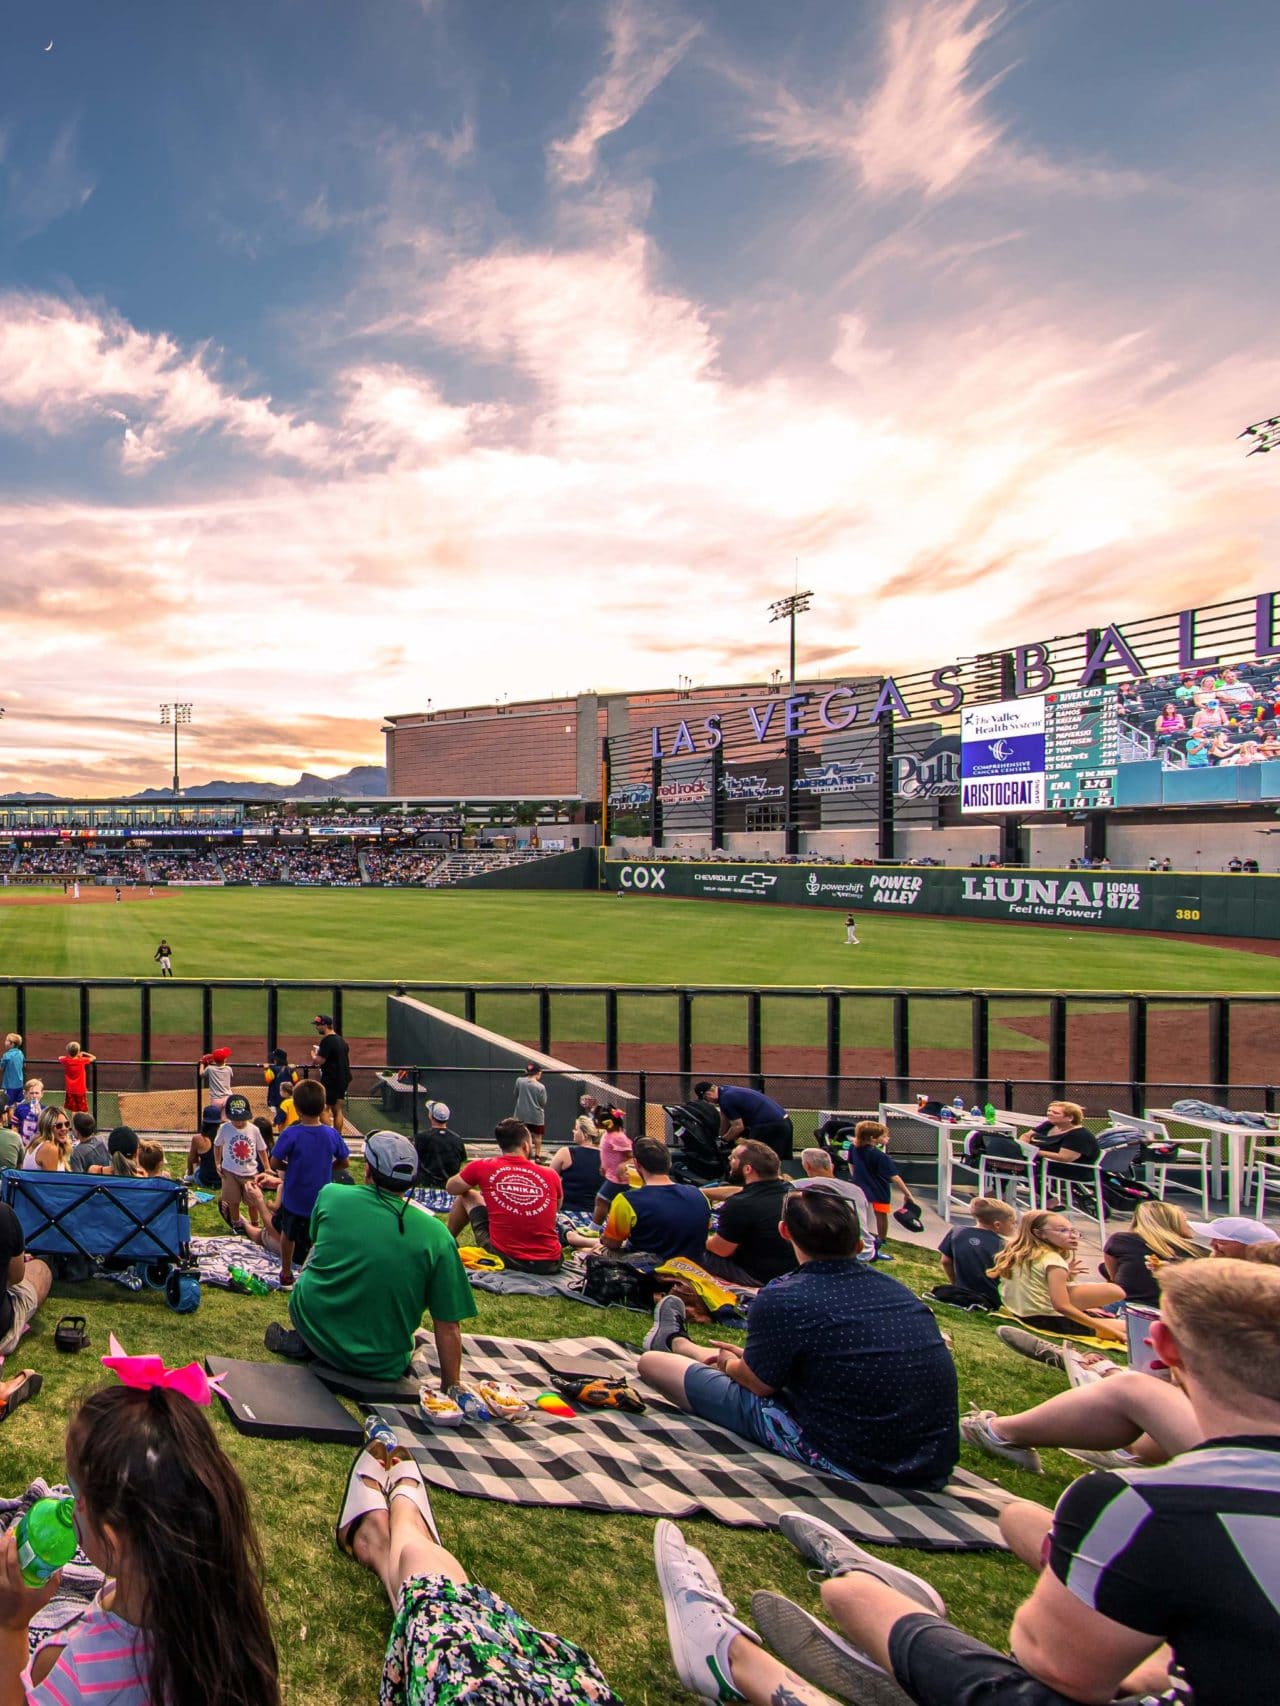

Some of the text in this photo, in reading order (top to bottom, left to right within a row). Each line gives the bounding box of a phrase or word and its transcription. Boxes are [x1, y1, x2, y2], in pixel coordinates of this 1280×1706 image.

[1060, 691, 1082, 702] RIVER
[1083, 688, 1101, 698] CATS
[652, 714, 723, 759] LAS
[748, 665, 965, 742] VEGAS
[991, 712, 1020, 724] Valley
[1056, 709, 1080, 717] RAMOS
[975, 721, 1041, 735] Health System
[972, 761, 1032, 771] COMPREHENSIVE
[793, 773, 874, 790] AMERICA FIRST
[1051, 779, 1109, 791] ERA 3.76
[963, 780, 1033, 808] ARISTOCRAT
[1096, 797, 1112, 808] 25
[620, 866, 665, 889] COX
[694, 873, 738, 883] CHEVROLET
[871, 875, 922, 891] POWER
[820, 883, 864, 893] powershift
[961, 876, 1104, 908] LiUNA!
[1106, 882, 1141, 894] LOCAL
[873, 889, 919, 904] ALLEY
[1106, 893, 1140, 910] 872
[1009, 904, 1103, 919] Feel the Power!
[1176, 909, 1200, 921] 380
[500, 1184, 539, 1194] LANIKAI
